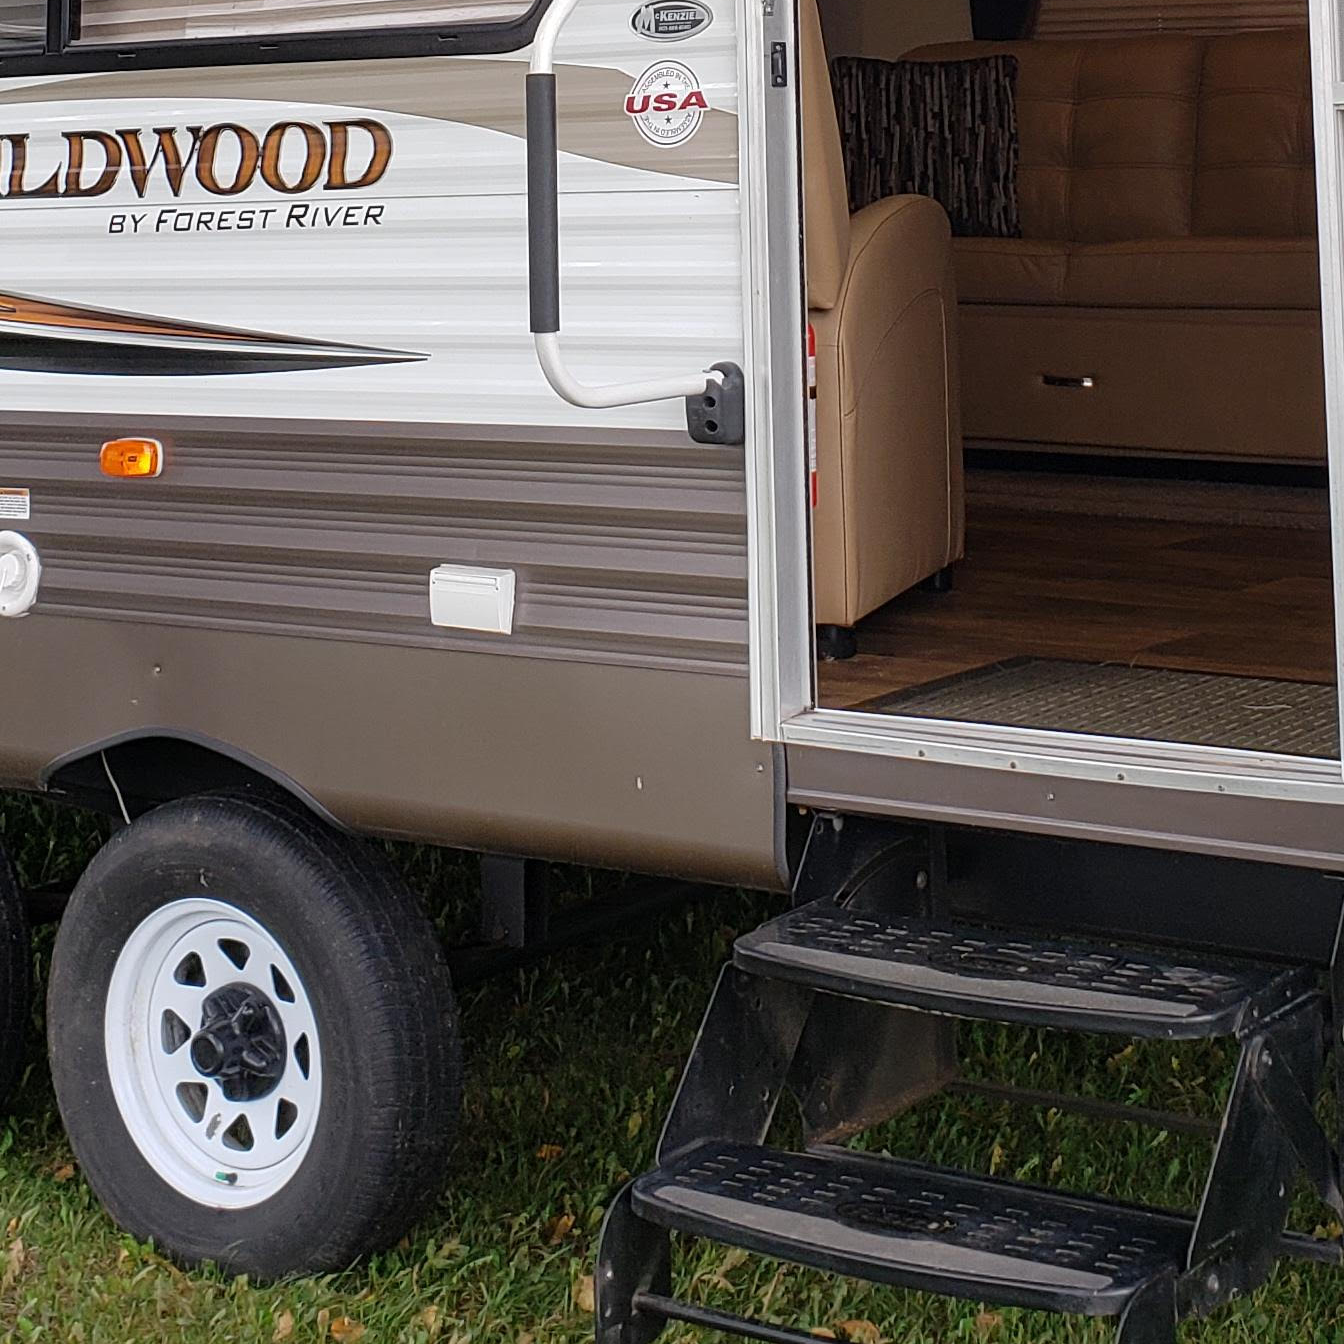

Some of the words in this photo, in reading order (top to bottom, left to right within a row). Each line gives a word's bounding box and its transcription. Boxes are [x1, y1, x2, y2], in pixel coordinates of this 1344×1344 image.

[625, 91, 709, 114] USA
[109, 213, 148, 234] BY
[155, 208, 277, 233] FOREST
[285, 203, 385, 228] RIVER
